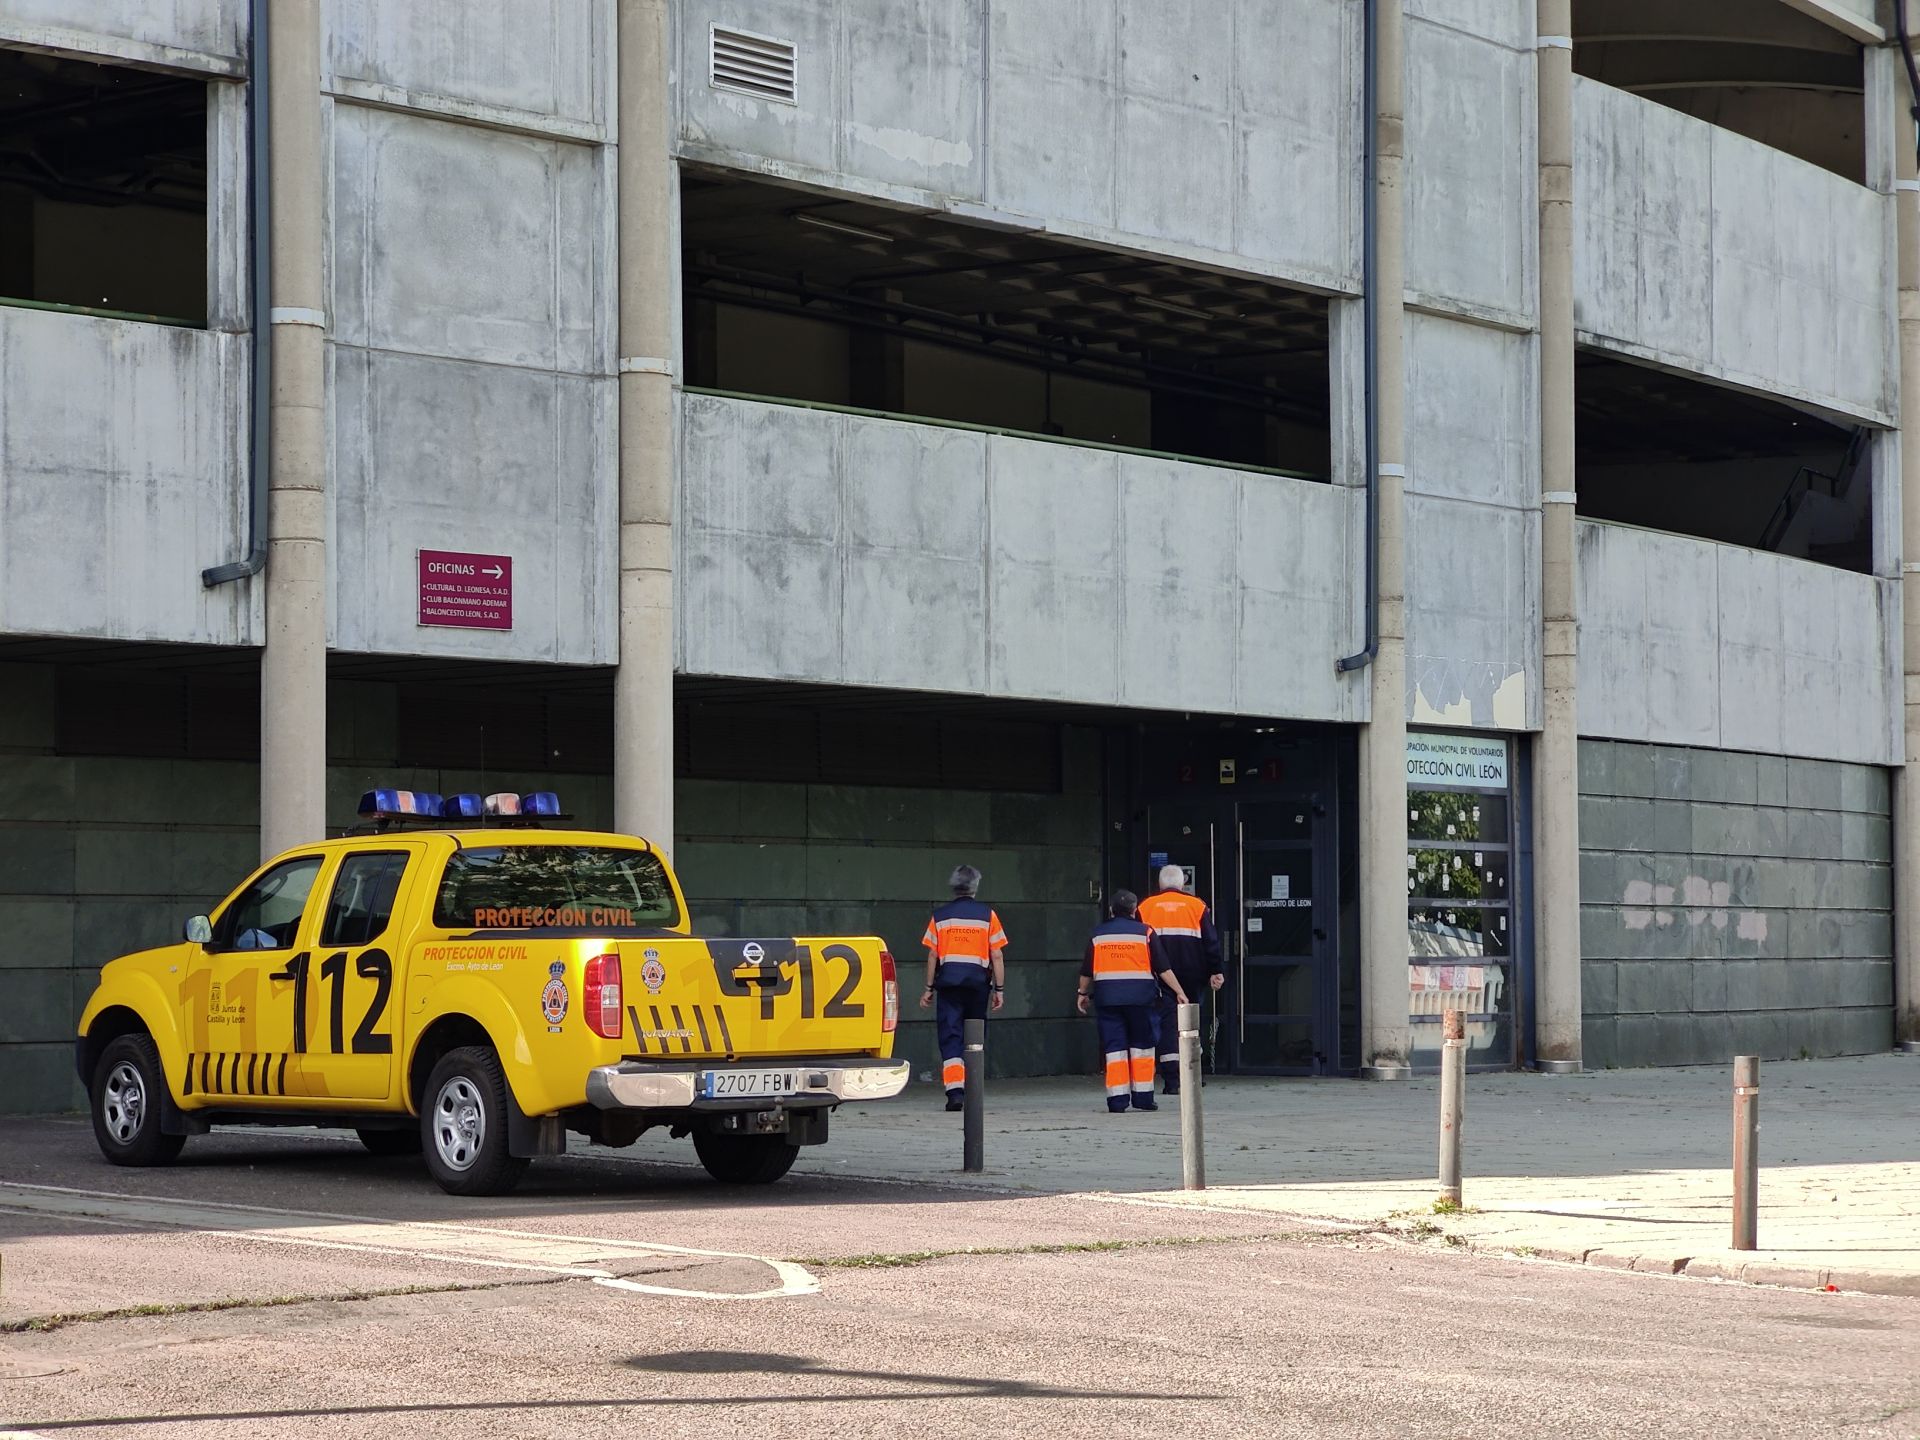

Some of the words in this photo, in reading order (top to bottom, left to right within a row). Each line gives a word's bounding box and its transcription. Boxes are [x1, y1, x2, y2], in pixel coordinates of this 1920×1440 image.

[428, 562, 475, 576] OFICINAS
[426, 583, 456, 592] CULTURAL
[426, 595, 442, 603] CLUB
[442, 596, 481, 606] BALONMANO
[482, 599, 508, 607] ADEMAR
[426, 607, 465, 617] BALONCESTO
[1431, 744, 1459, 755] MUNICIPAL
[1460, 746, 1469, 755] DE
[1469, 747, 1504, 758] VOLUNTARIOS
[1407, 758, 1453, 776] OTECCIÓN
[1455, 763, 1477, 778] CIVIL
[1479, 762, 1502, 779] LEÓN
[474, 908, 587, 927] PROTECCION
[591, 908, 636, 927] CIVIL
[423, 947, 495, 960] PROTECCION
[498, 946, 528, 960] CIVIL
[286, 948, 393, 1054] 112
[222, 1005, 237, 1013] Junta
[238, 1005, 246, 1013] de
[207, 1015, 225, 1023] Castilla
[717, 1075, 757, 1093] 2707
[763, 1073, 792, 1091] FBW
